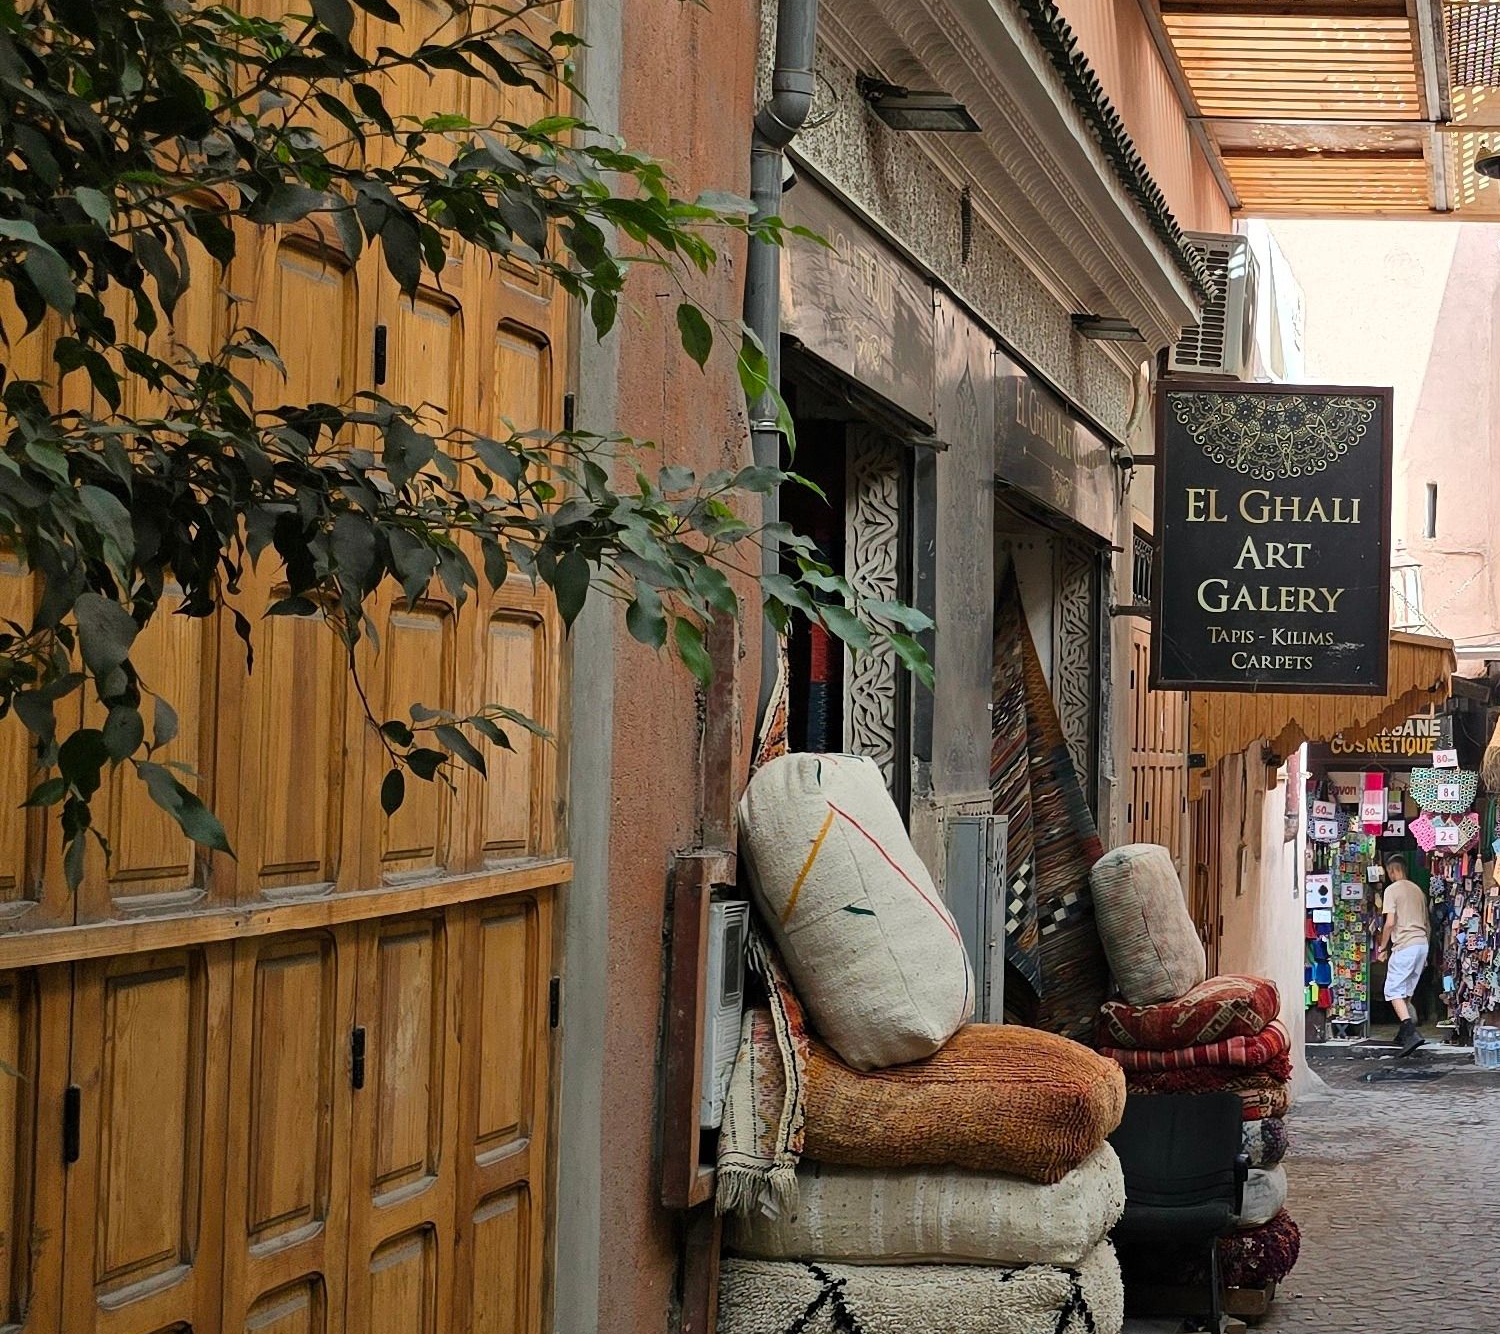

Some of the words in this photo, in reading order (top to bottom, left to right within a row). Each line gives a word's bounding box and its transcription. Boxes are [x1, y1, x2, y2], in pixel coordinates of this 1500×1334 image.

[1185, 487, 1227, 522] EL
[1239, 489, 1361, 524] GHALI
[1233, 535, 1312, 570] ART
[1197, 578, 1345, 613] GALERY
[1206, 626, 1255, 645] TAPIS
[1271, 627, 1334, 646] KILIMS
[1231, 652, 1313, 670] CARPETS
[1376, 719, 1440, 736] GANE
[1440, 831, 1447, 841] 2
[1346, 886, 1352, 895] 5
